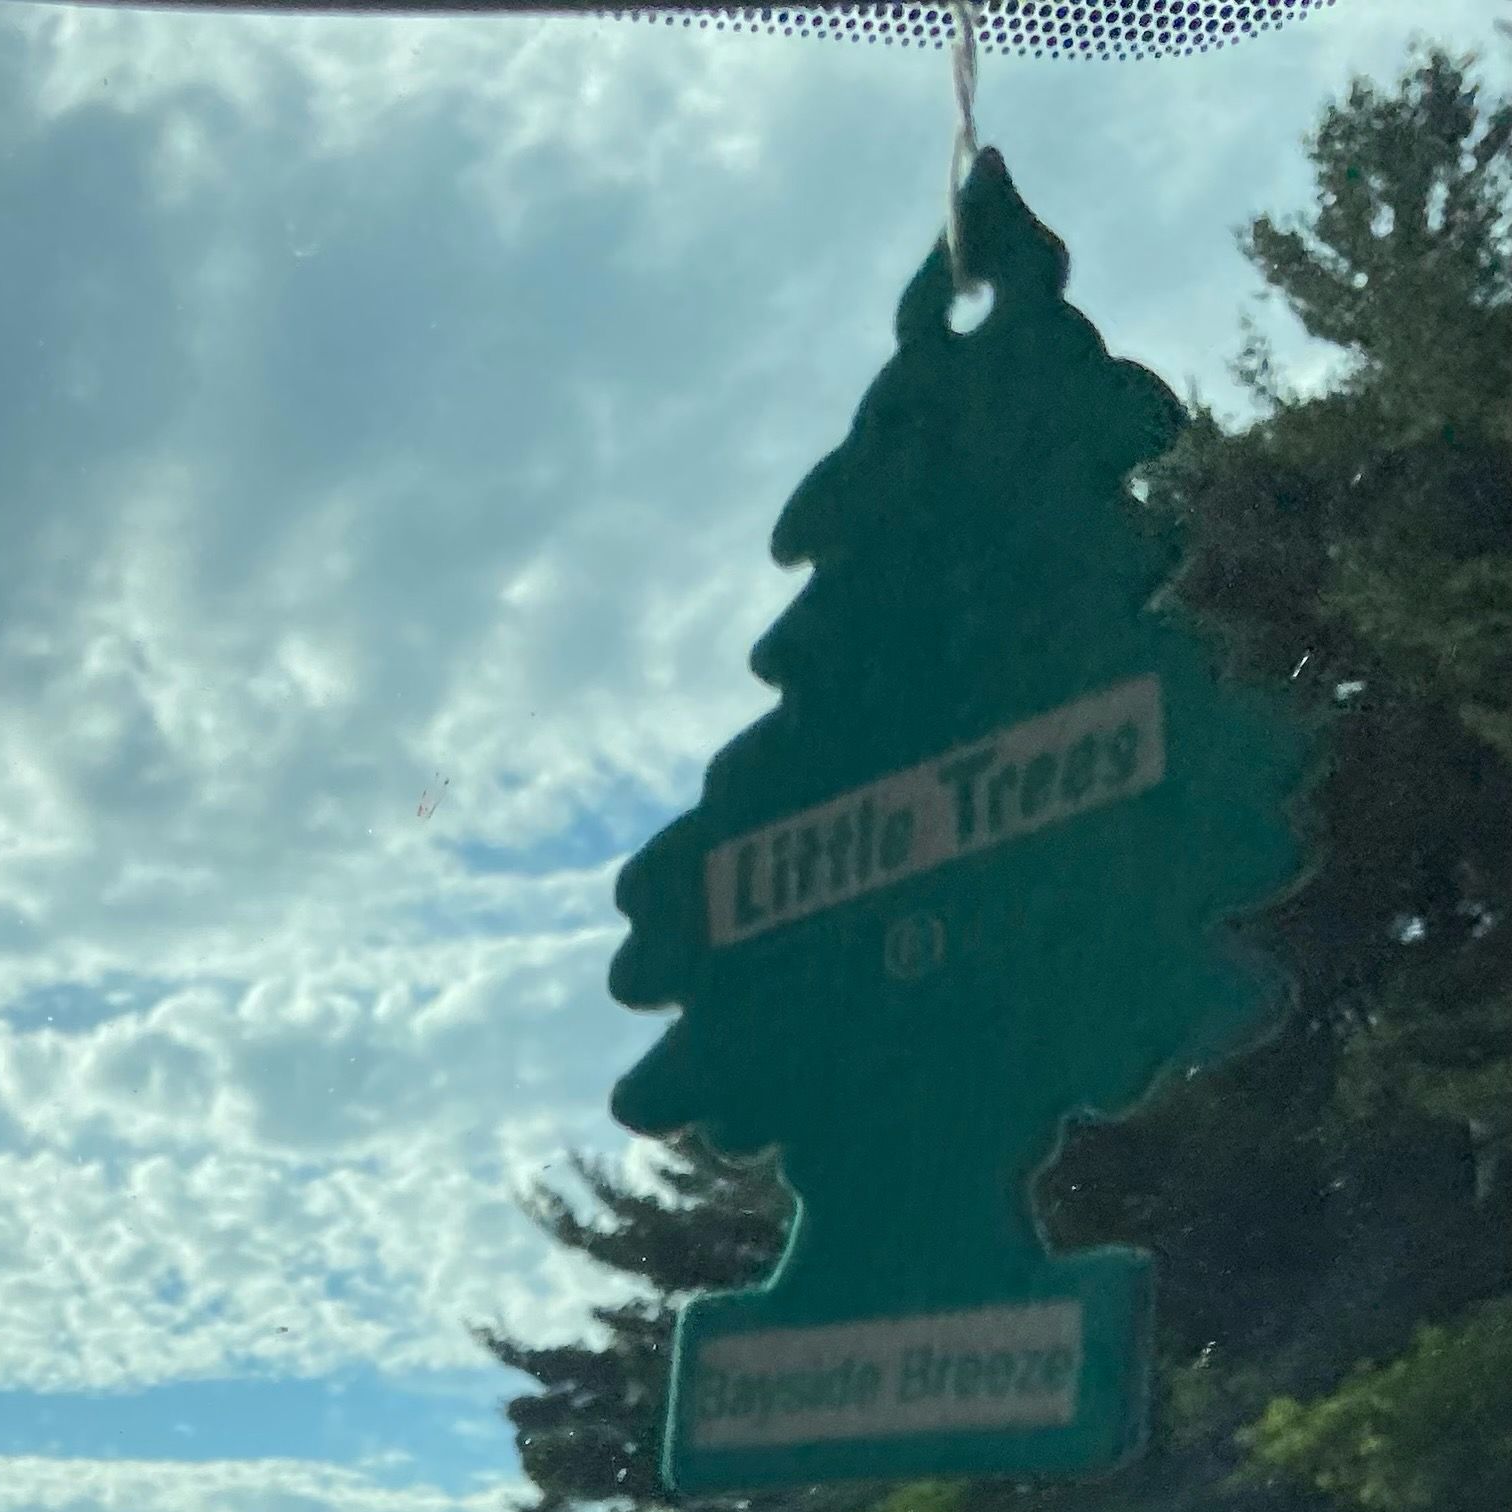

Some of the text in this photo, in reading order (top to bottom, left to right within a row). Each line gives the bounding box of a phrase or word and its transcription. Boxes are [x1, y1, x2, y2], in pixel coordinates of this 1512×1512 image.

[733, 719, 1139, 927] Little Trees
[897, 1343, 1074, 1404] Breeze
